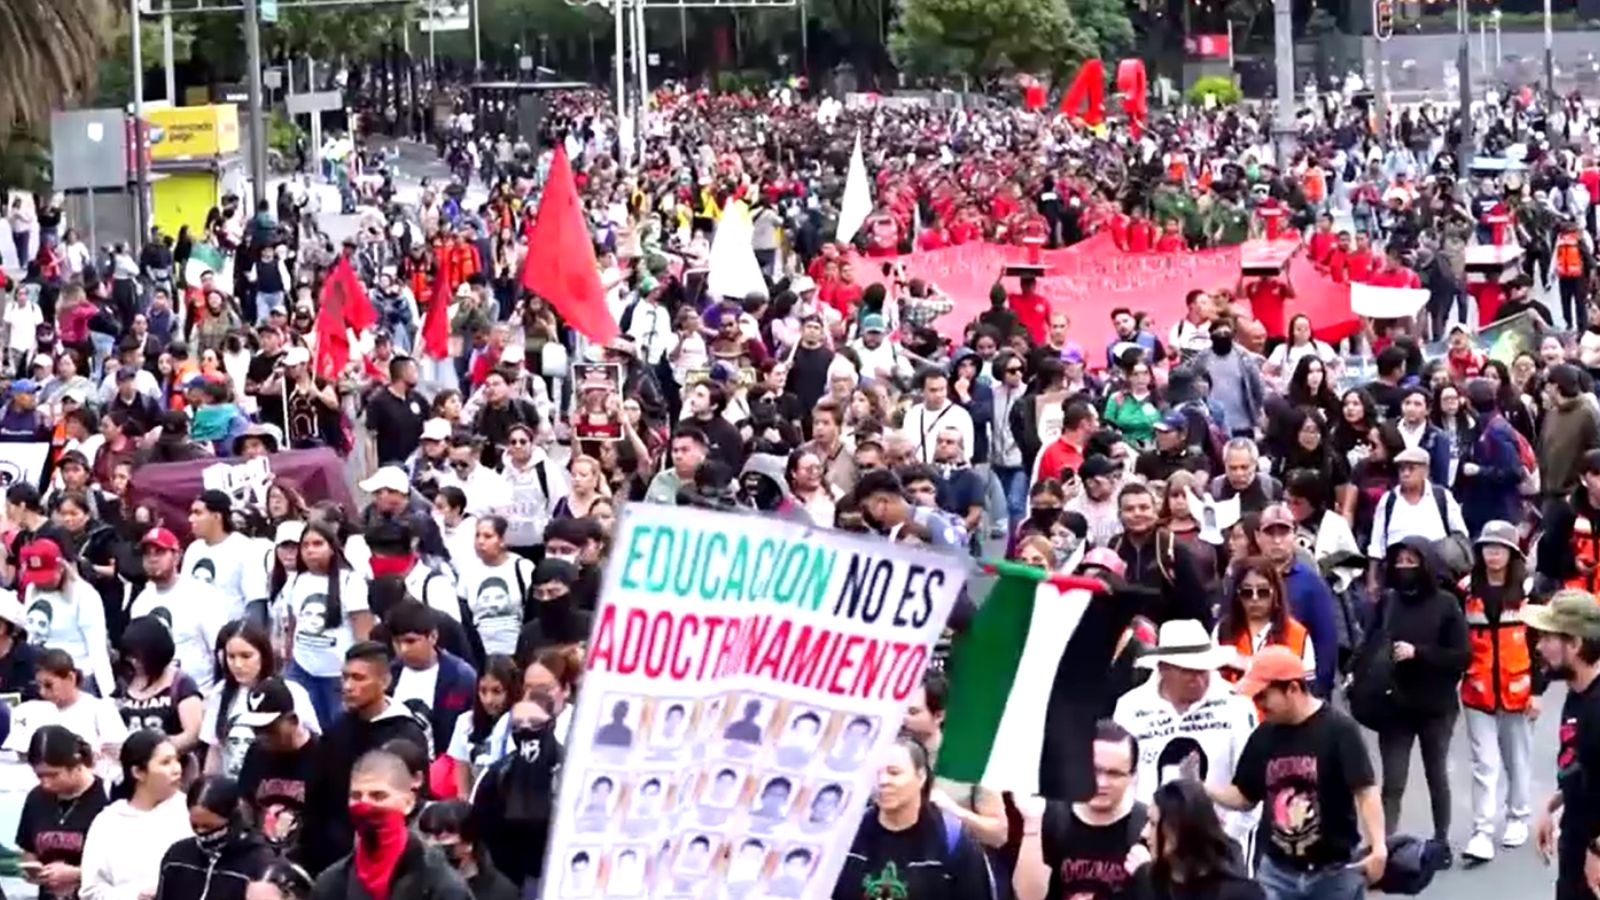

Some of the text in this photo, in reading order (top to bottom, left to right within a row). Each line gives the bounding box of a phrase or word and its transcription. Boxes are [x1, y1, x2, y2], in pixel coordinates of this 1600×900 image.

[832, 552, 893, 624] NO
[892, 564, 945, 630] ES
[588, 604, 927, 701] ADOCTRINAMIENTO
